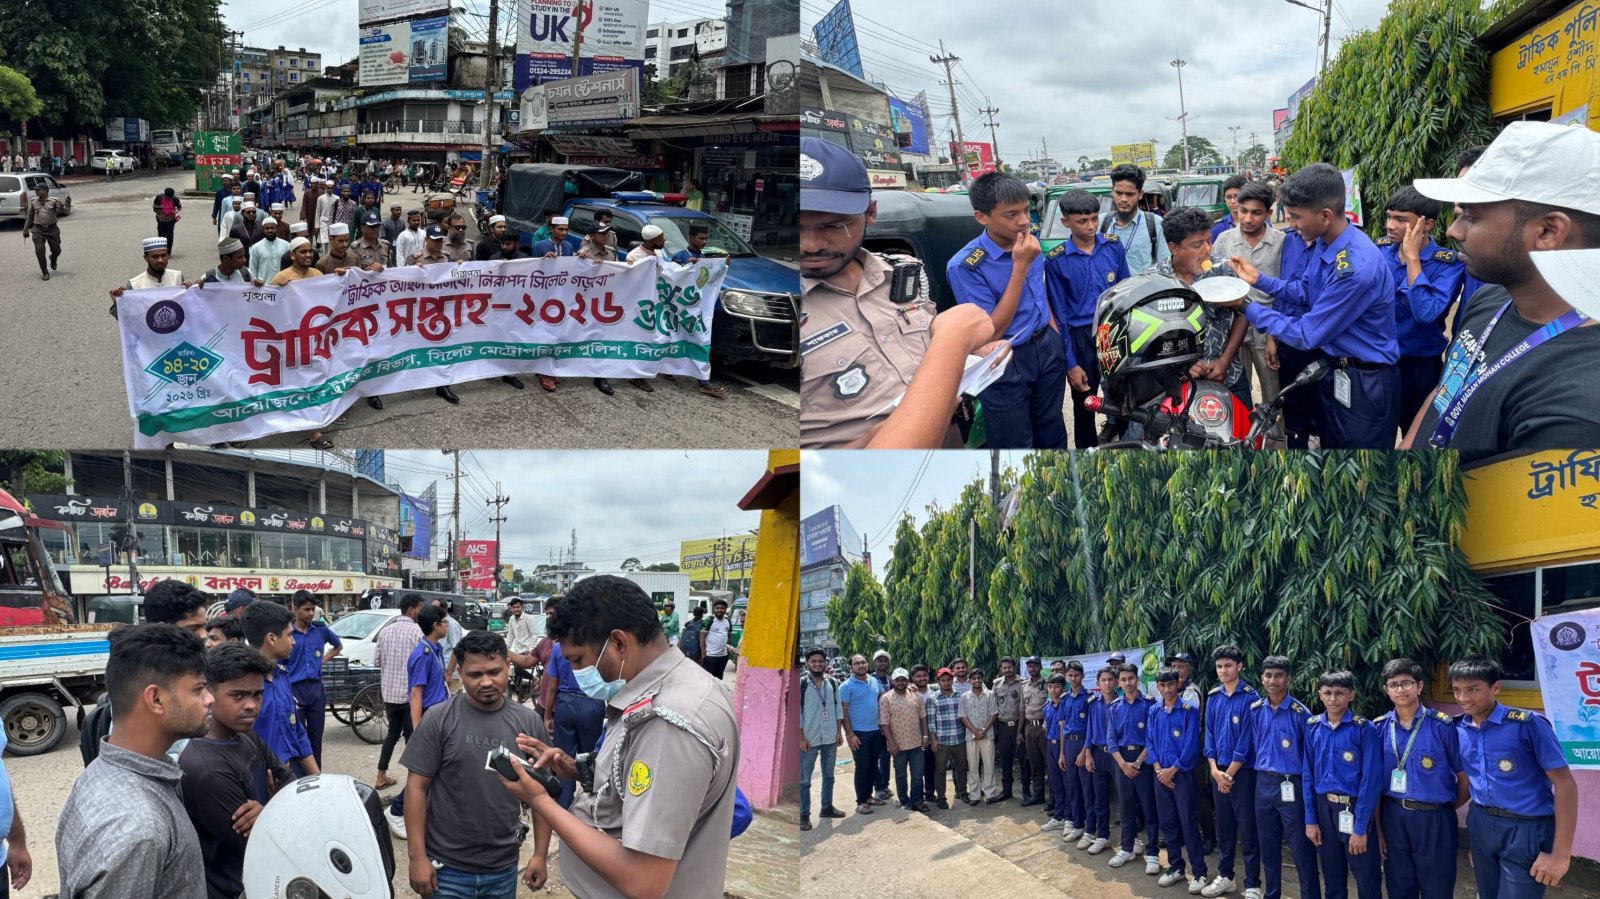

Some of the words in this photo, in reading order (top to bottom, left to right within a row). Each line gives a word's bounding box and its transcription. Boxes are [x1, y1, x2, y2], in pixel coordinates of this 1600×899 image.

[530, 13, 571, 43] UK
[1516, 29, 1561, 70] ট্রাফিক
[1564, 4, 1600, 49] পুলি
[703, 135, 732, 144] BRAND
[733, 134, 751, 143] EYE
[752, 133, 780, 143] WEAR
[477, 270, 528, 289] নিরাপদ
[529, 269, 570, 290] সিলেট
[1157, 297, 1186, 311] STUDDS
[240, 304, 381, 387] ট্রাফিক
[427, 344, 474, 364] সিলেট
[163, 357, 210, 374] ১৪-২০
[175, 373, 199, 389] জুন
[1449, 403, 1465, 420] GOVT.
[1460, 383, 1479, 405] MADAN
[1477, 363, 1501, 386] MOHAN
[1500, 341, 1532, 366] COLLEGE
[166, 390, 194, 403] ২০২৬
[466, 543, 488, 554] AKS
[204, 576, 262, 590] বনফুল
[284, 577, 334, 593] Banoful
